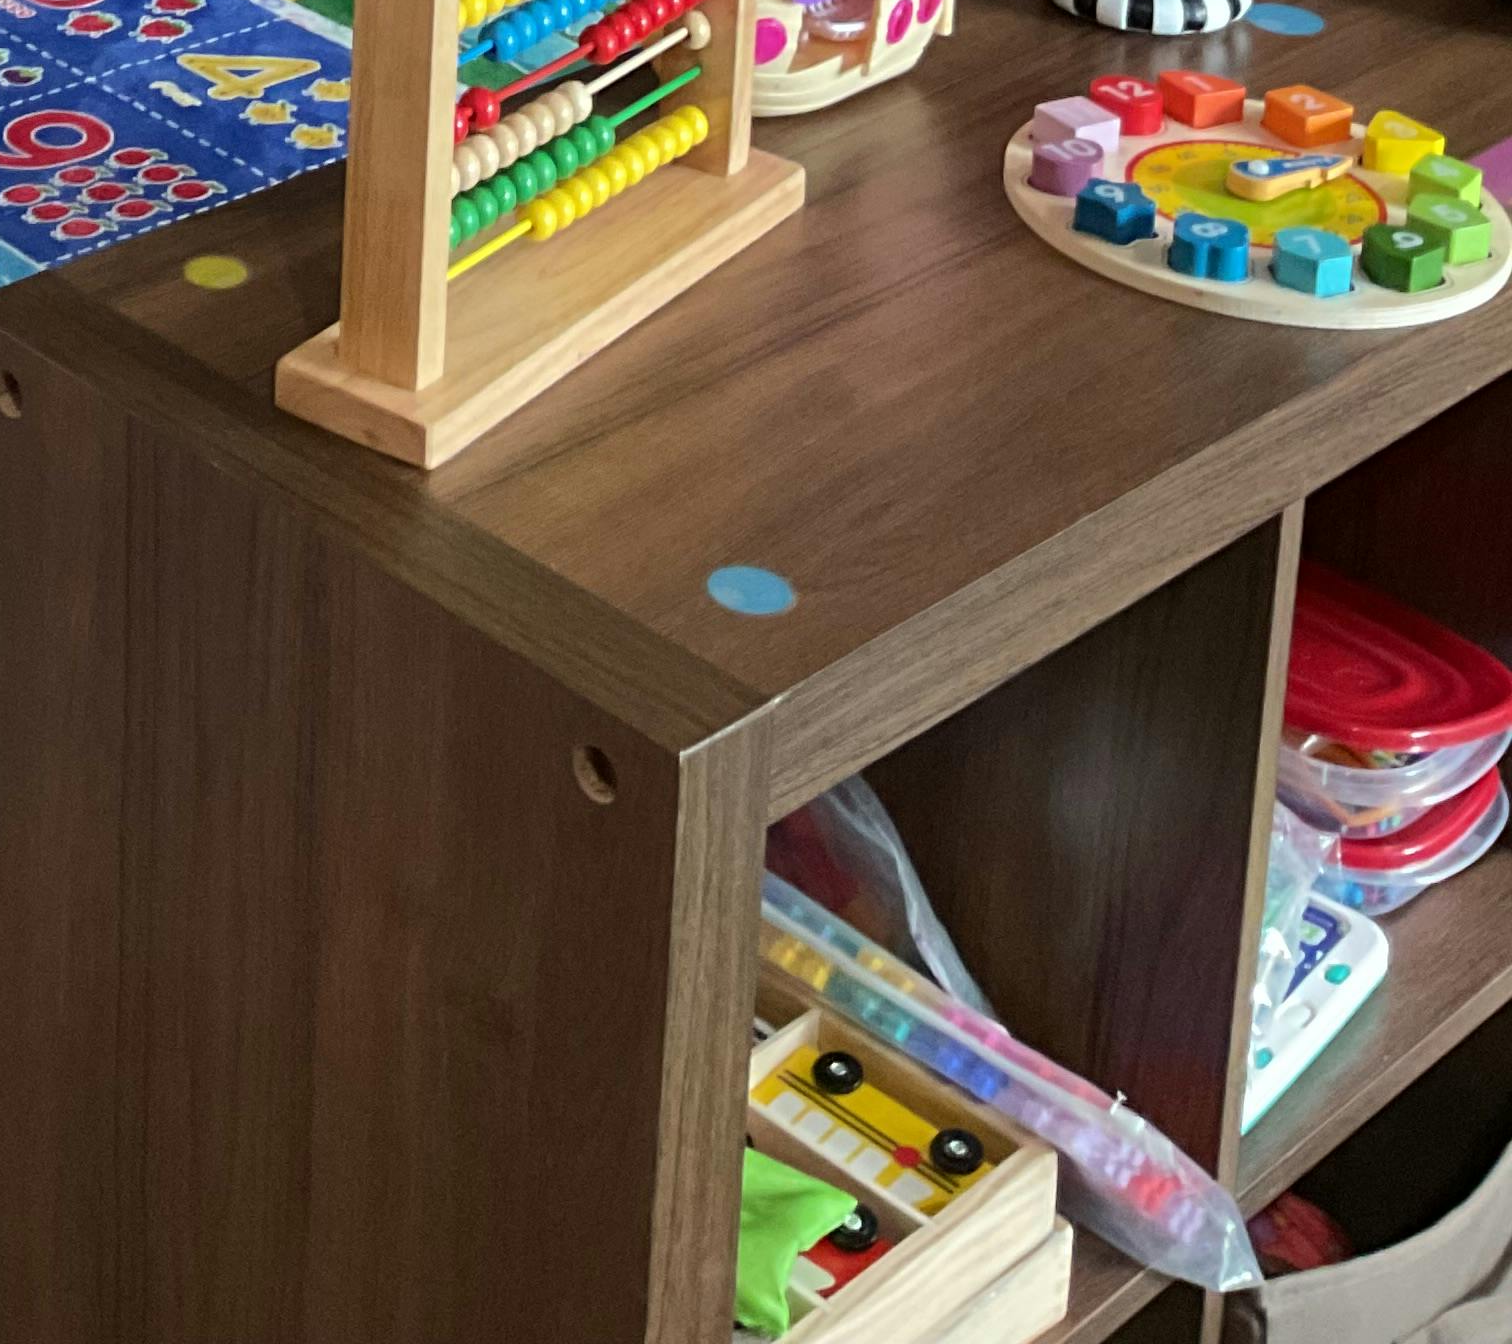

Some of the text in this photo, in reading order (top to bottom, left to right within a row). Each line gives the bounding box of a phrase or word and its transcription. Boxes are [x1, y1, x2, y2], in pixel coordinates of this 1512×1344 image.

[175, 53, 323, 102] 4
[1182, 75, 1214, 92] 1
[1097, 80, 1155, 101] 12
[1290, 92, 1326, 111] 2
[1043, 138, 1097, 161] 10
[1094, 184, 1125, 203] 9
[1190, 220, 1229, 239] 8
[1292, 235, 1322, 254] 7
